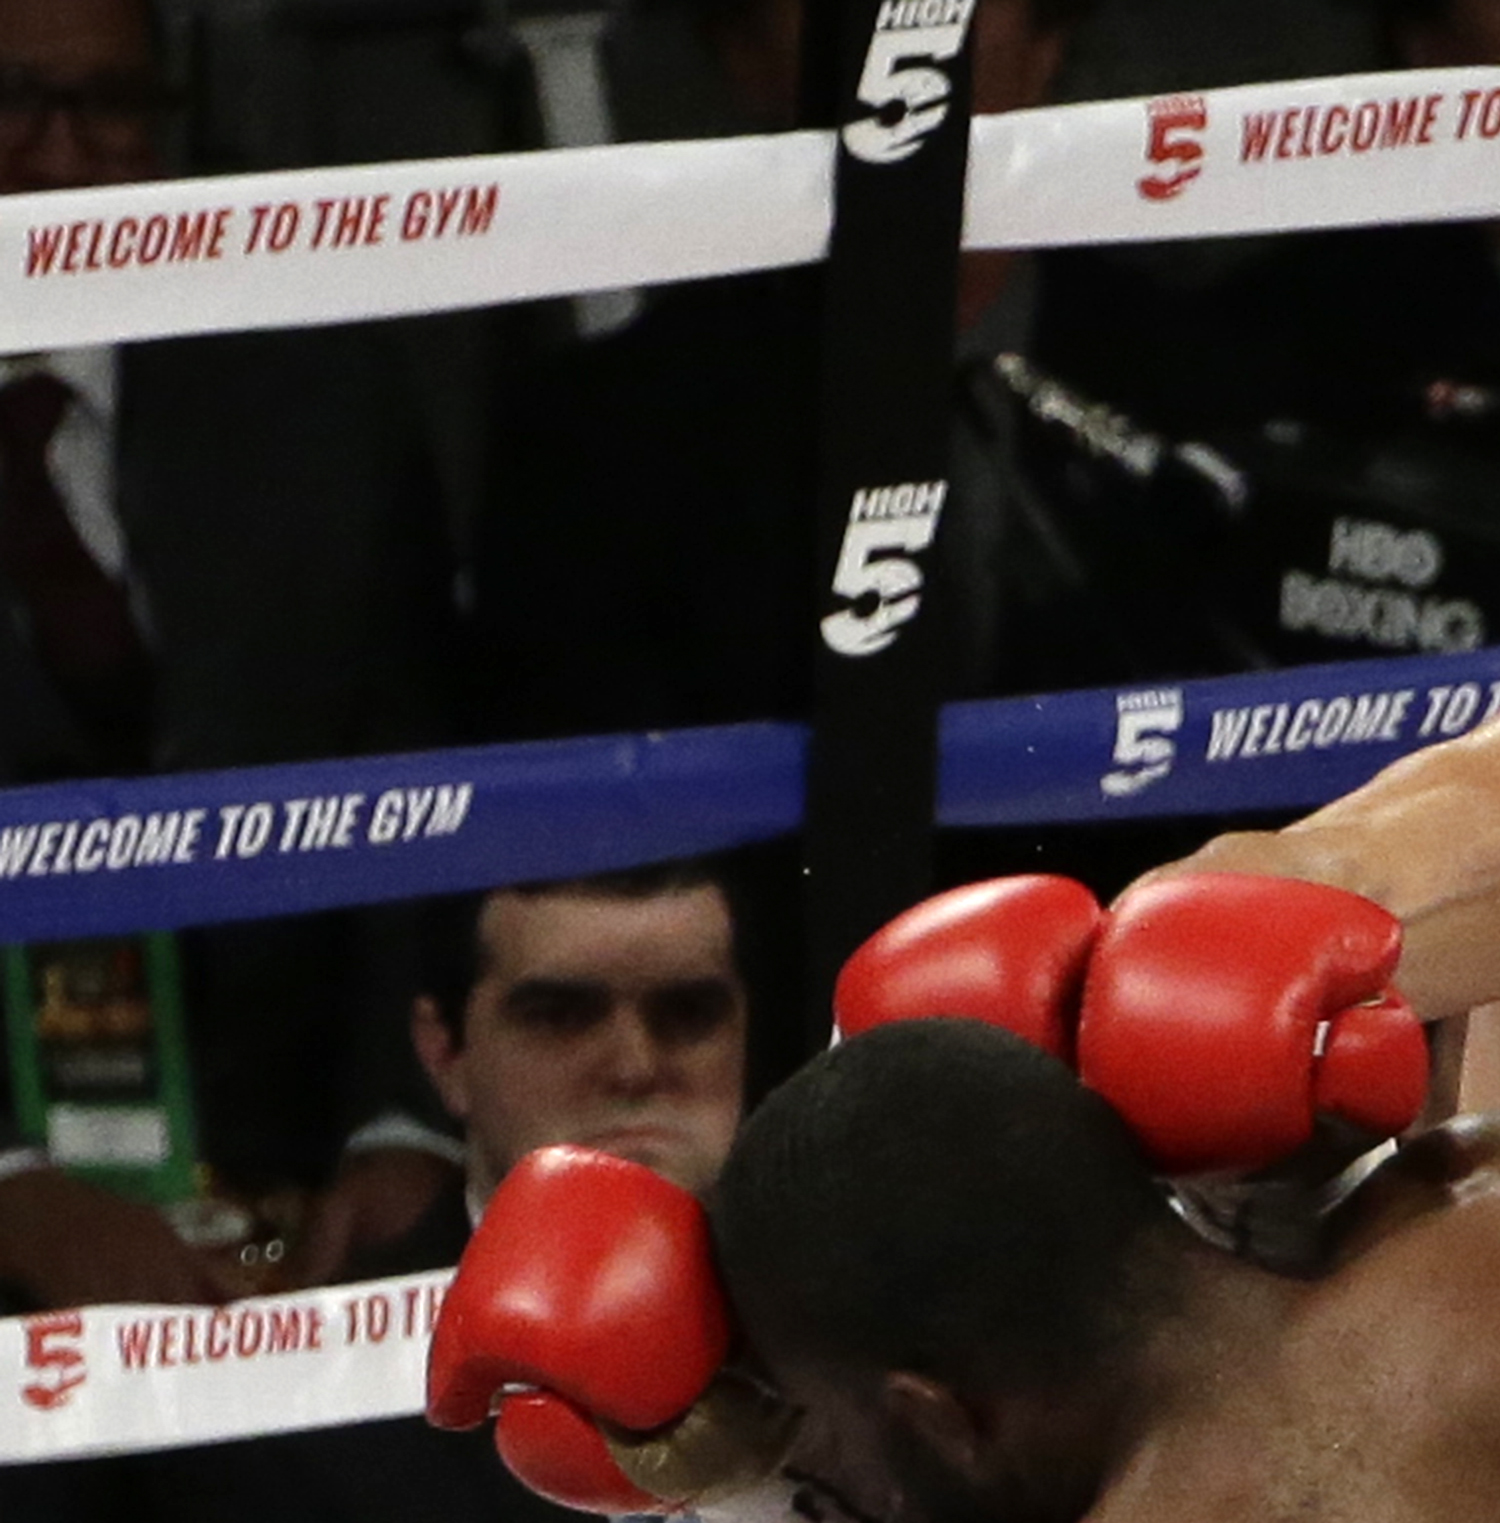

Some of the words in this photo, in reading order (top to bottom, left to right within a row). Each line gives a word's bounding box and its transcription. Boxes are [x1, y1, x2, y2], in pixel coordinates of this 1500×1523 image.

[876, 0, 976, 31] HIGH
[841, 24, 966, 164] 5
[1240, 94, 1443, 165] WELCOME
[1136, 112, 1207, 201] 5
[23, 205, 229, 279] WELCOME
[243, 203, 300, 256] TO
[310, 195, 391, 248] THE
[400, 183, 500, 241] GYM
[849, 480, 947, 523] HIGH
[820, 513, 938, 658] 5
[1100, 709, 1182, 797] 5
[1206, 690, 1417, 762] WELCOME
[1417, 681, 1482, 738] TO
[0, 808, 206, 880] WELCOME
[214, 801, 273, 861] TO
[281, 794, 364, 850] THE
[369, 784, 472, 843] GYM
[21, 1318, 86, 1411] 5
[119, 1307, 323, 1370] WELCOME
[345, 1294, 391, 1346] TO
